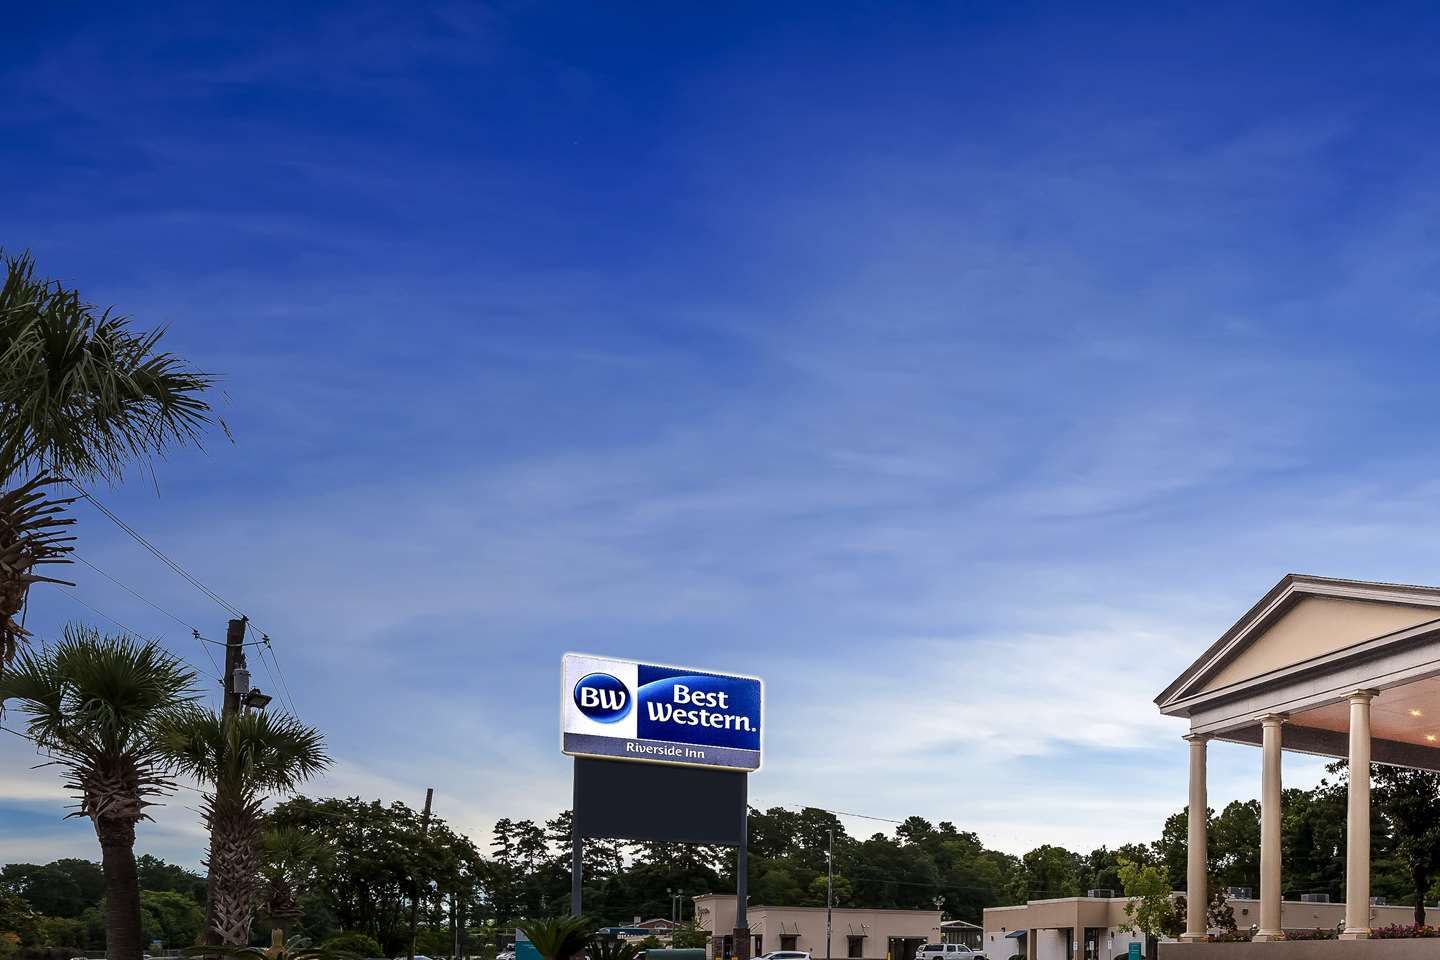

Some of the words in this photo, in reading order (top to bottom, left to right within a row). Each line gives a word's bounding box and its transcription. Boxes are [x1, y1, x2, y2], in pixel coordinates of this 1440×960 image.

[581, 687, 626, 710] BW
[673, 684, 729, 709] Best
[626, 742, 682, 757] Riverside
[685, 748, 705, 759] Inn
